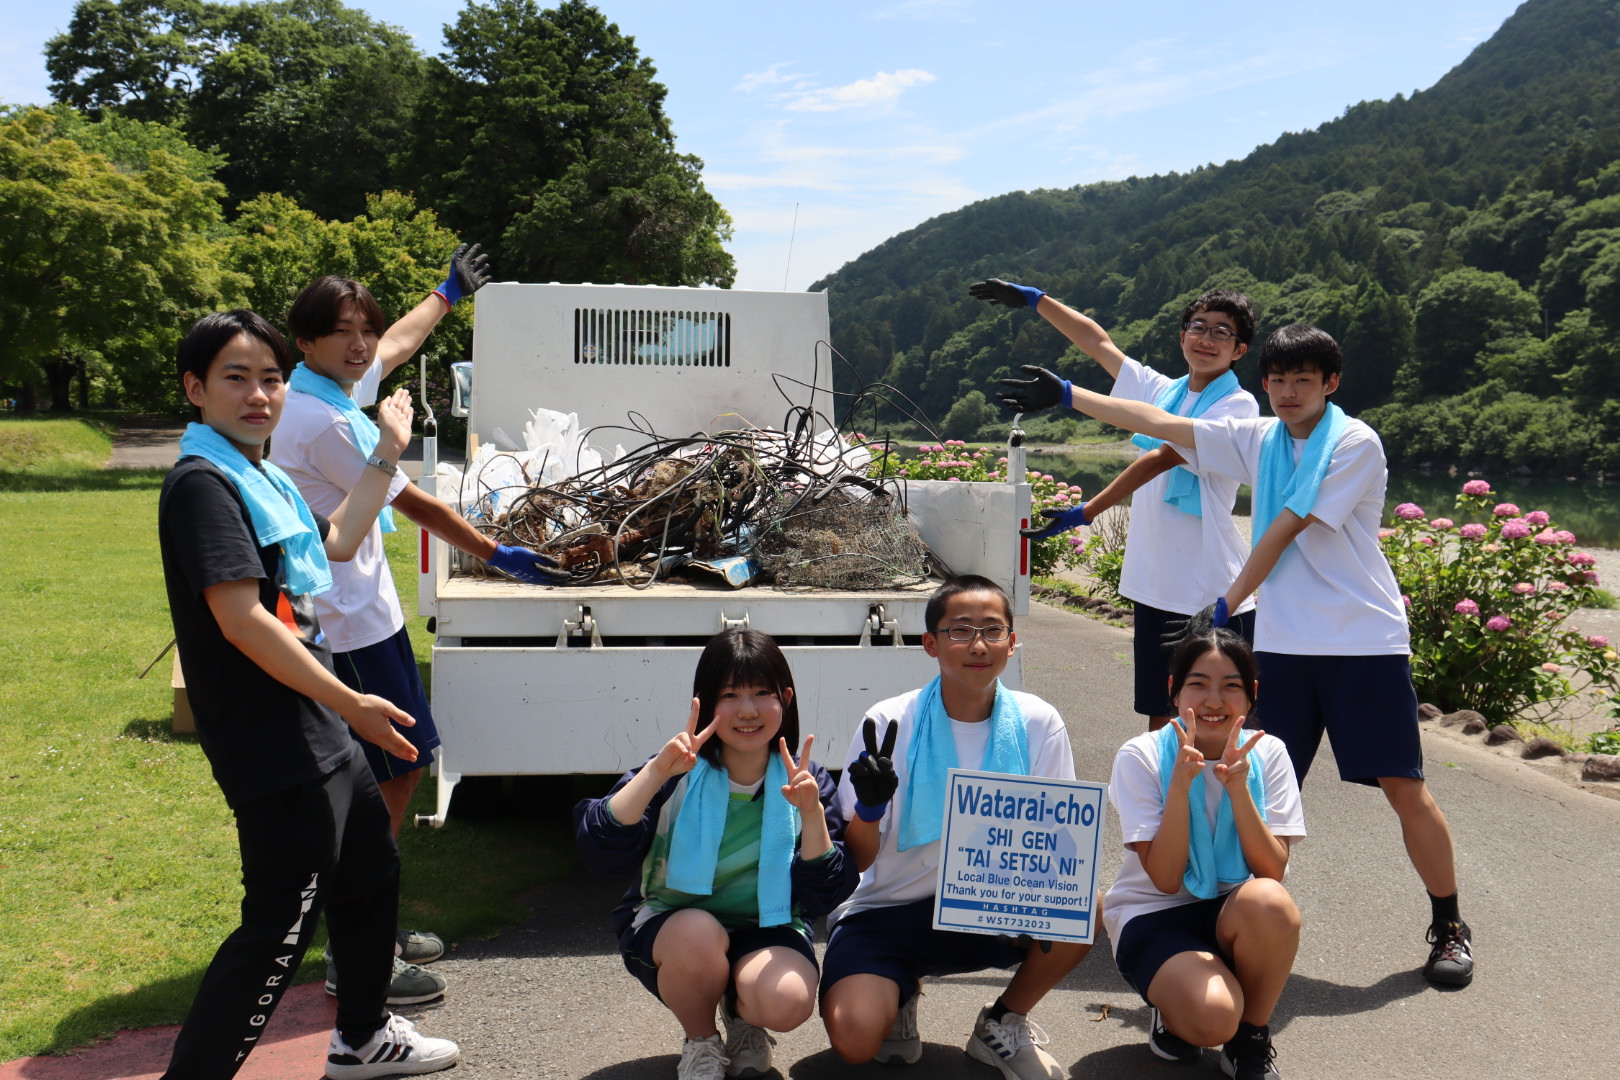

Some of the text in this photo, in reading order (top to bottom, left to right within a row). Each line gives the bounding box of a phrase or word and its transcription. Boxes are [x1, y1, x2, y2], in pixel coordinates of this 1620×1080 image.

[957, 784, 1095, 826] Watarai-cho
[987, 826, 1058, 852] SHI GEN
[999, 851, 1051, 874] SETSU
[946, 883, 977, 896] Thank
[980, 888, 998, 899] you
[1001, 888, 1015, 900] for
[1018, 891, 1042, 903] your
[958, 871, 1078, 892] Local Blue Ocean Vision
[983, 903, 1049, 915] HASHTAG
[235, 954, 293, 1061] TIGORA
